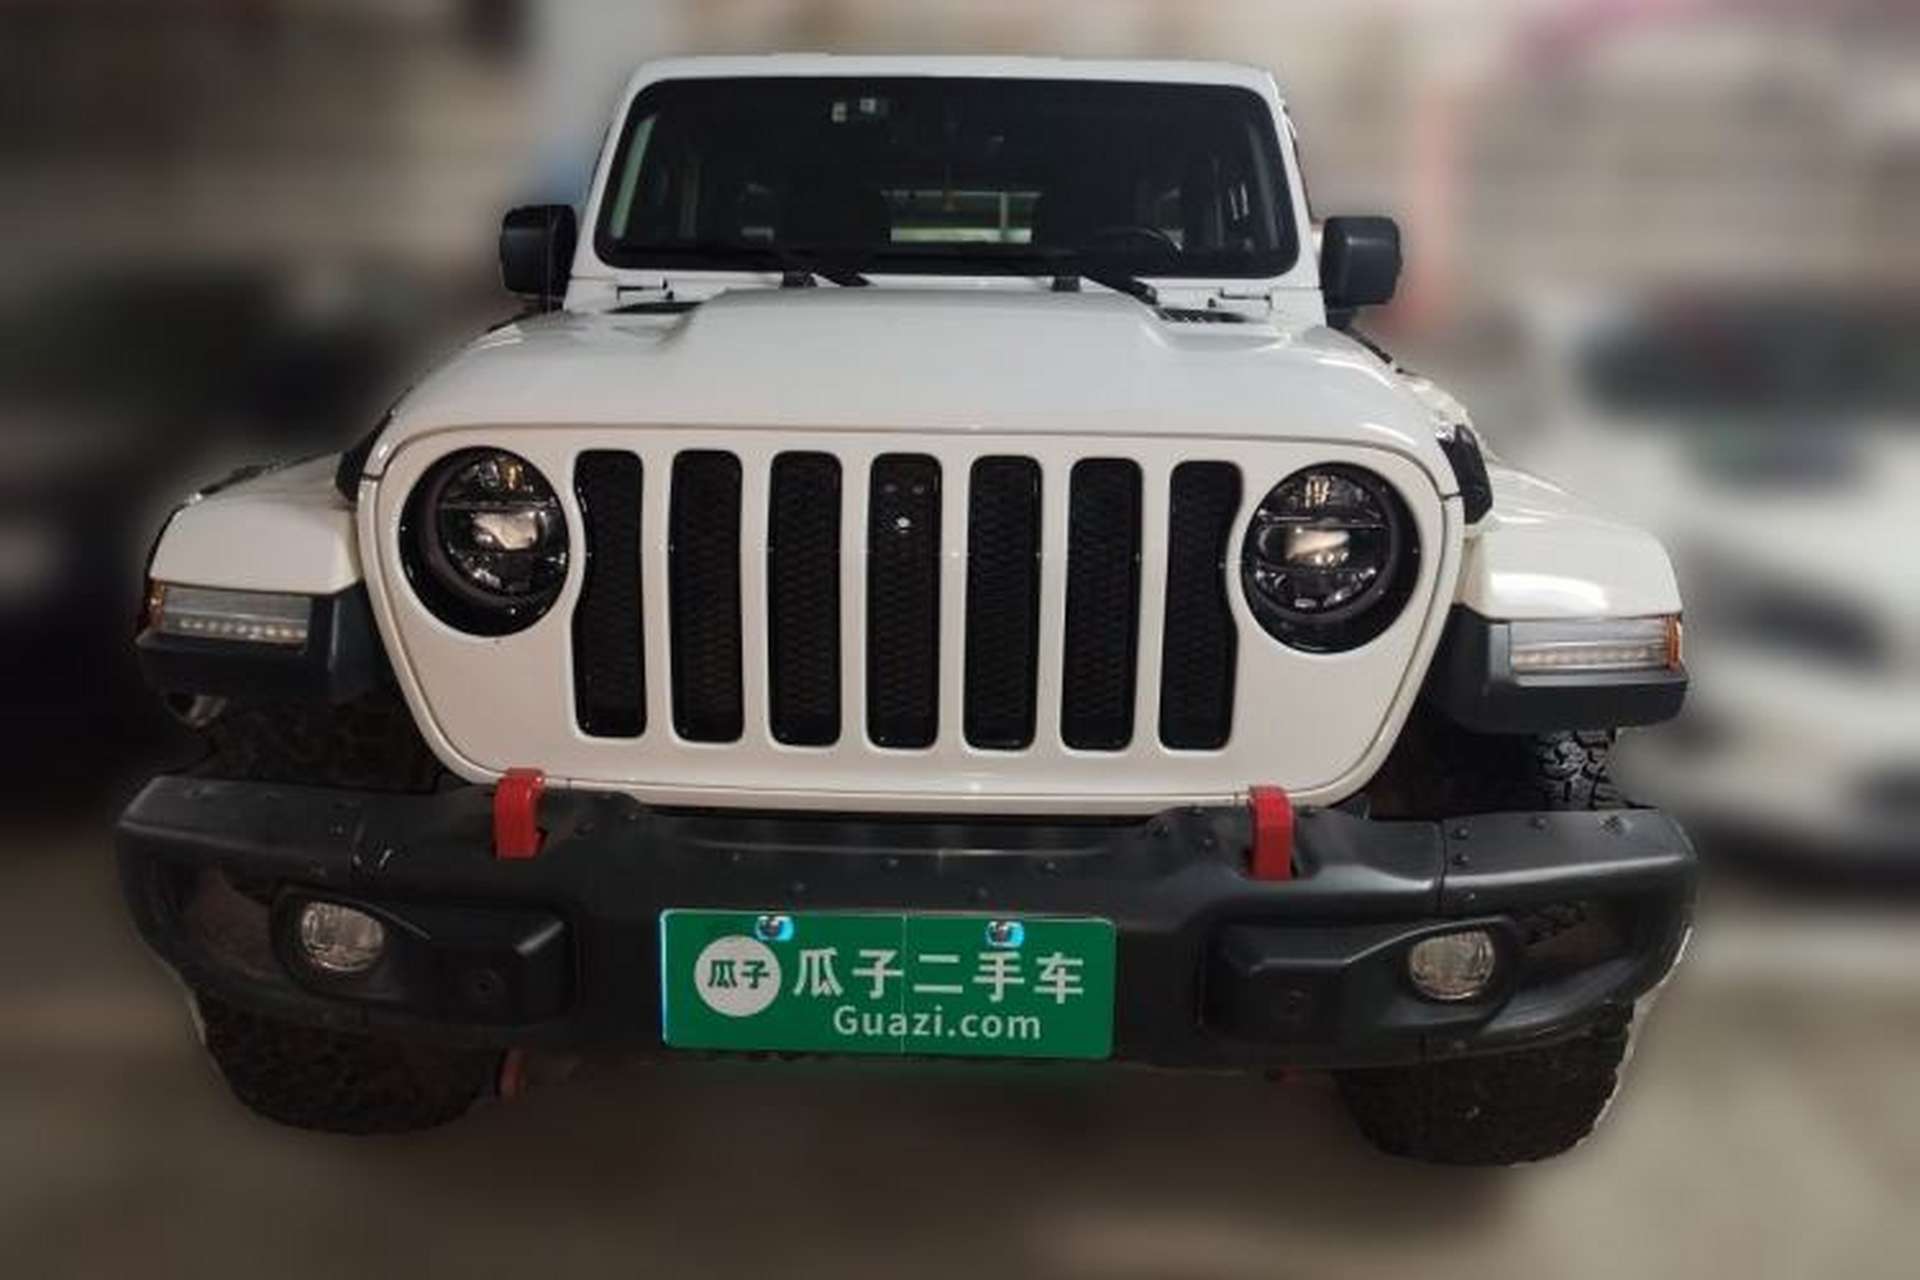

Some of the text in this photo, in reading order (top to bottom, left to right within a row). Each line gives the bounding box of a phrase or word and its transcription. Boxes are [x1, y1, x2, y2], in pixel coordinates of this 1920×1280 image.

[707, 959, 770, 989] 瓜子
[793, 948, 1084, 1004] 瓜子二手车
[833, 1005, 1041, 1039] Guazi.com
